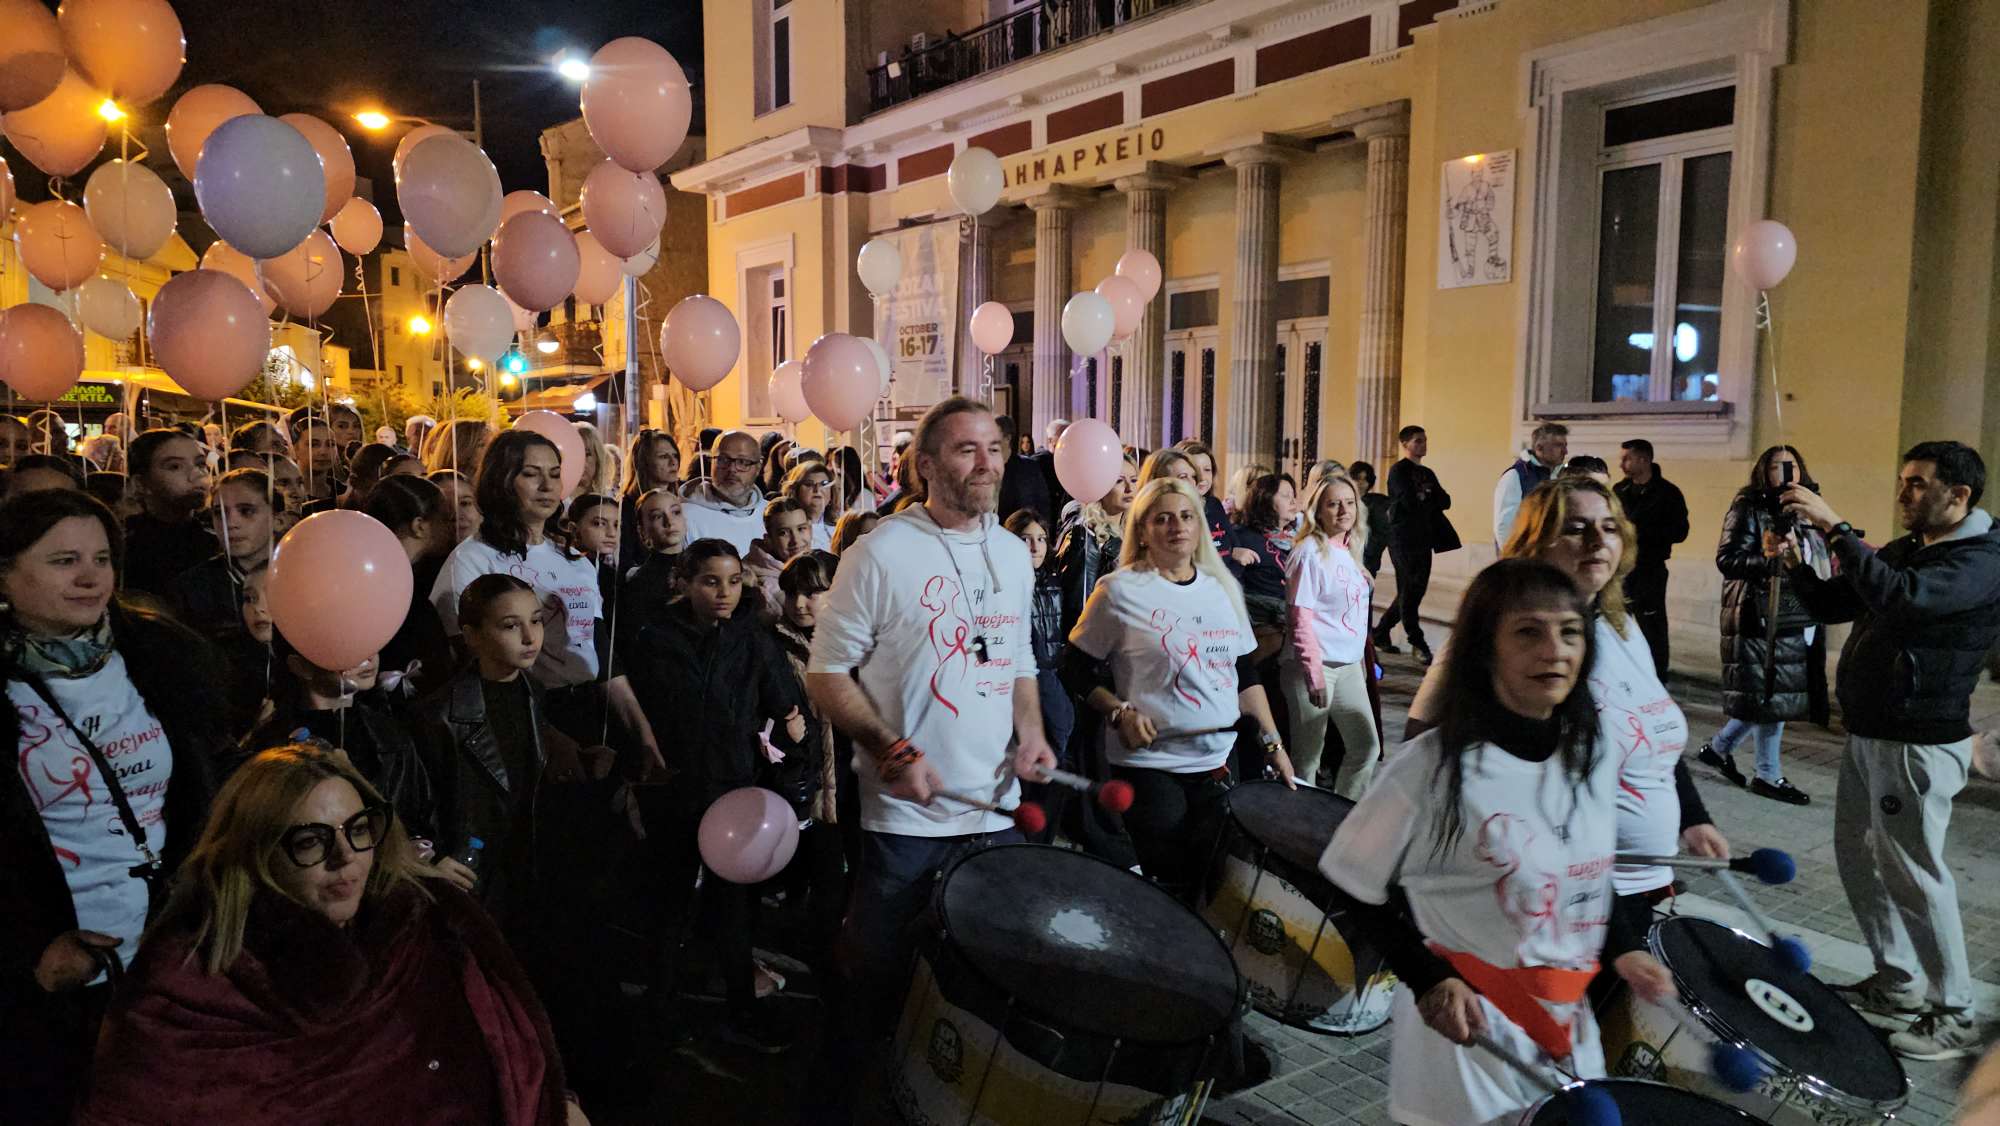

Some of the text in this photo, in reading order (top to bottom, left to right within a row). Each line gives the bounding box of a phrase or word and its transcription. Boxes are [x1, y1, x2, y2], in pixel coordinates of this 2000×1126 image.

[899, 322, 939, 335] OCTOBER
[899, 335, 939, 357] 16-17
[114, 759, 156, 779] ίναι
